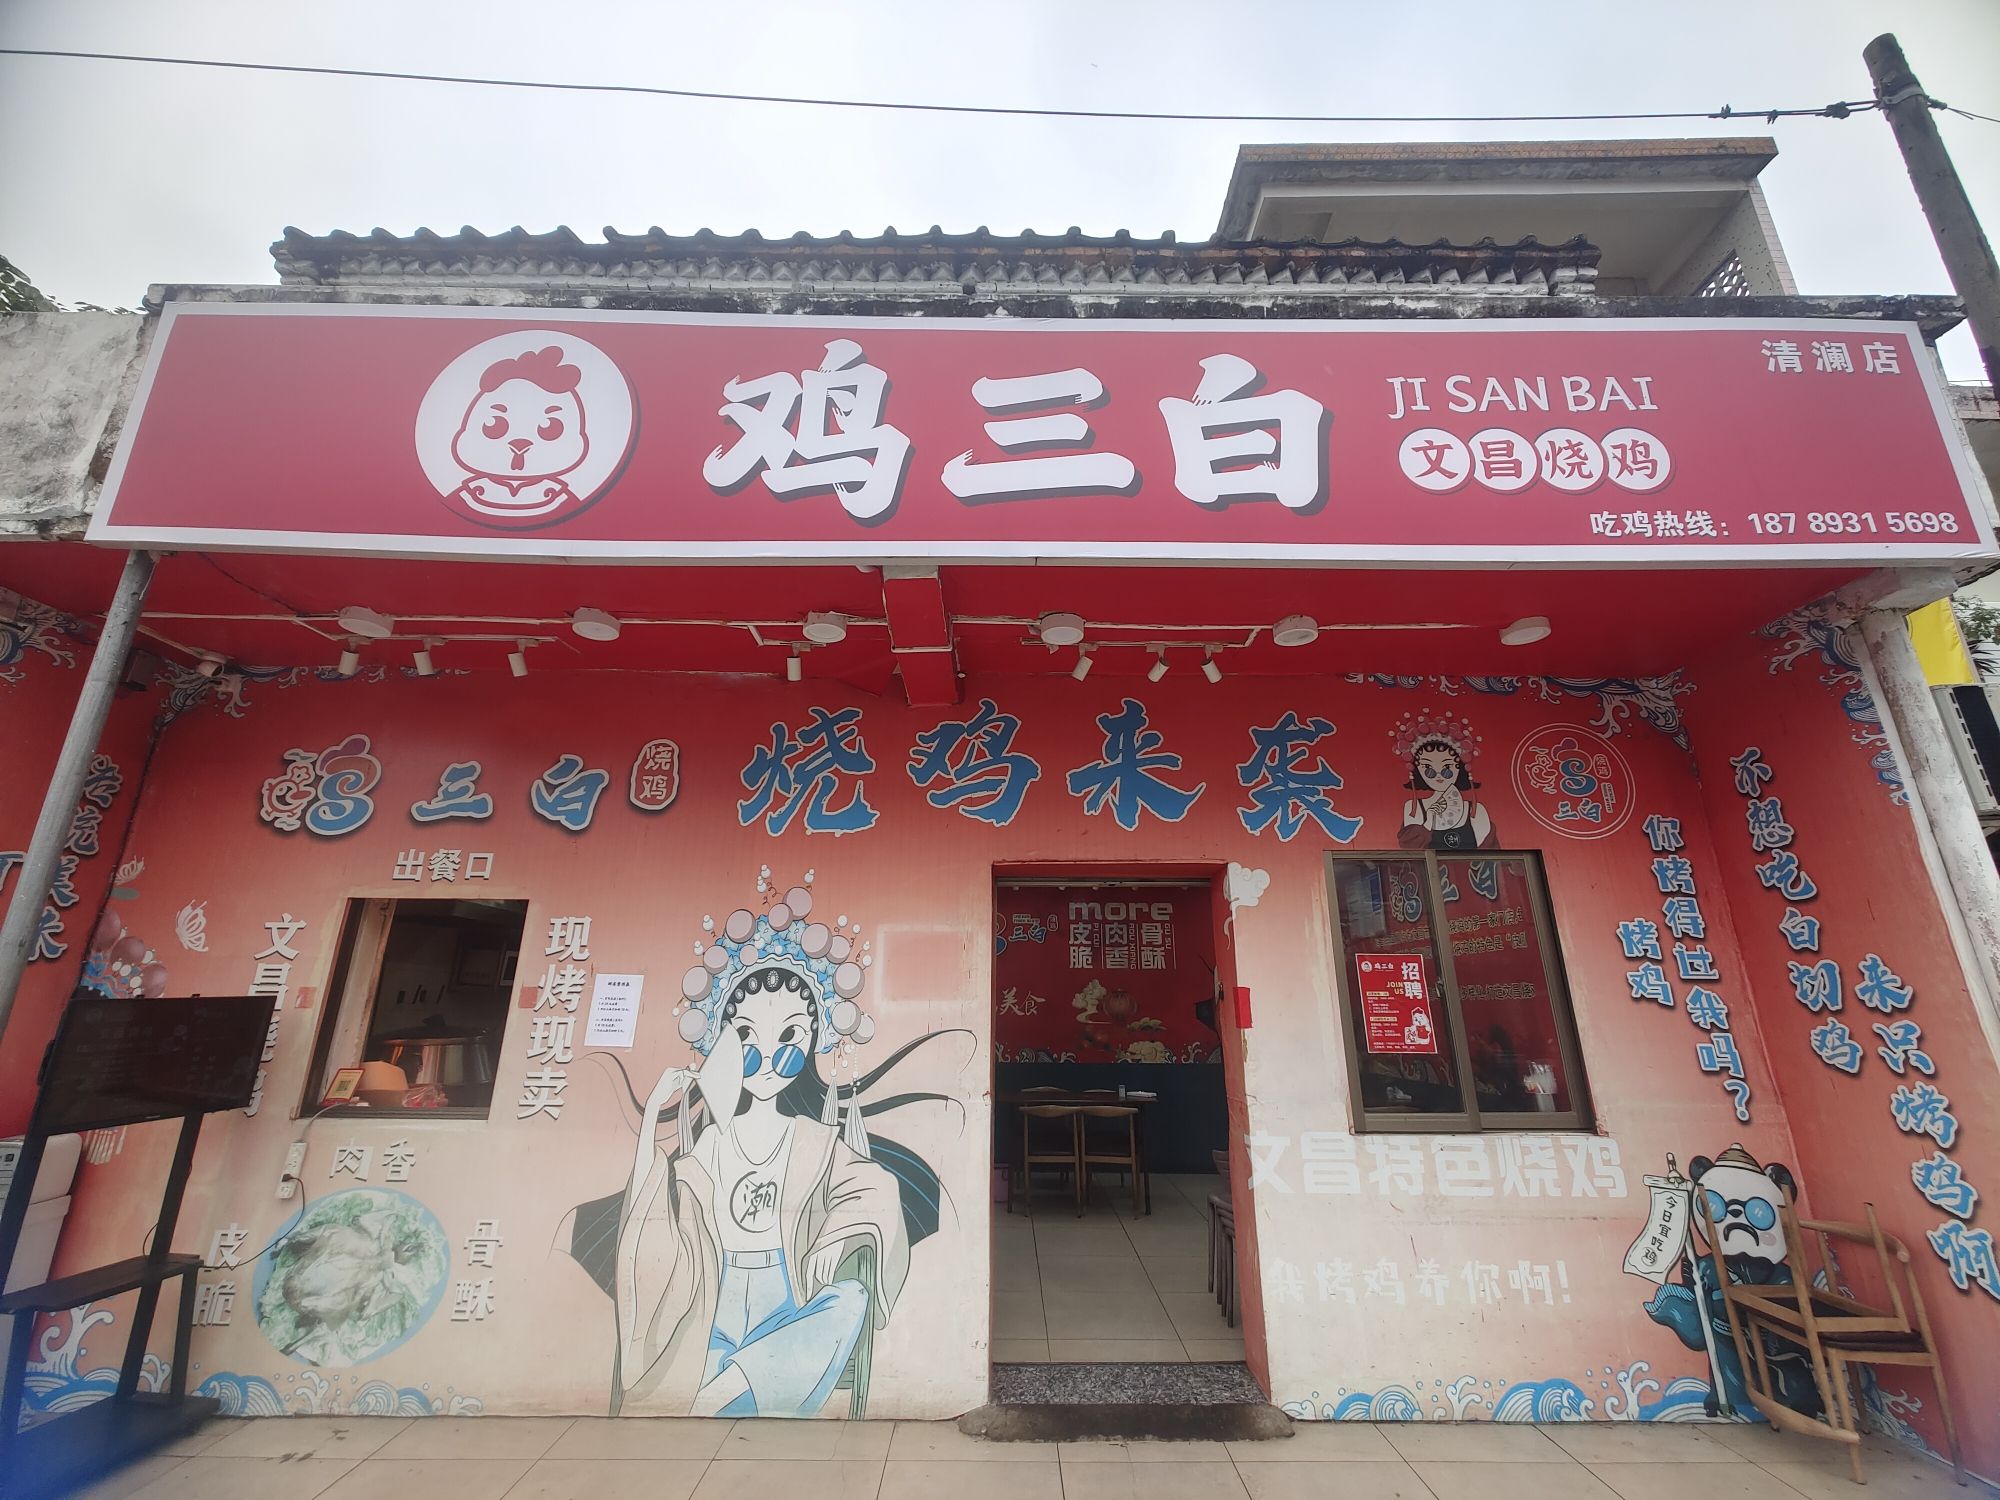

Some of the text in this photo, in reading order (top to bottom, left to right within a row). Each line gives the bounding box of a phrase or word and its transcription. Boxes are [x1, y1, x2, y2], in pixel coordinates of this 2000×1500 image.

[1761, 339, 1902, 375] 清澜店
[1387, 375, 1660, 419] JI SAN BAI
[703, 339, 1325, 519] 鸡三白
[1407, 436, 1663, 486] 文昌烧鸡
[1589, 509, 1960, 539] 吃鸡热线： 187 8931 5698
[637, 743, 675, 804] 烧鸡
[736, 697, 1363, 844] 烧鸡来袭
[391, 848, 495, 883] 出餐口
[1068, 902, 1174, 921] more
[1729, 746, 1863, 1074] 不想吃白切鸡
[1068, 921, 1094, 969] 皮脆
[1104, 921, 1129, 969] 肉香
[1140, 922, 1167, 970] 骨酥
[1617, 918, 1675, 1008] 烤鸡
[1643, 814, 1752, 1122] 你烤得过我吗？
[999, 986, 1047, 1017] 美食
[1401, 961, 1423, 1000] 招聘
[241, 913, 308, 1118] 文昌
[515, 914, 593, 1122] 现烤现卖
[329, 1138, 417, 1184] 肉香
[1243, 1130, 1628, 1199] 文昌特色烧鸡
[1642, 1195, 1678, 1265] 今日宜吃鸡
[191, 1222, 250, 1328] 皮脆
[449, 1218, 504, 1323] 骨酥
